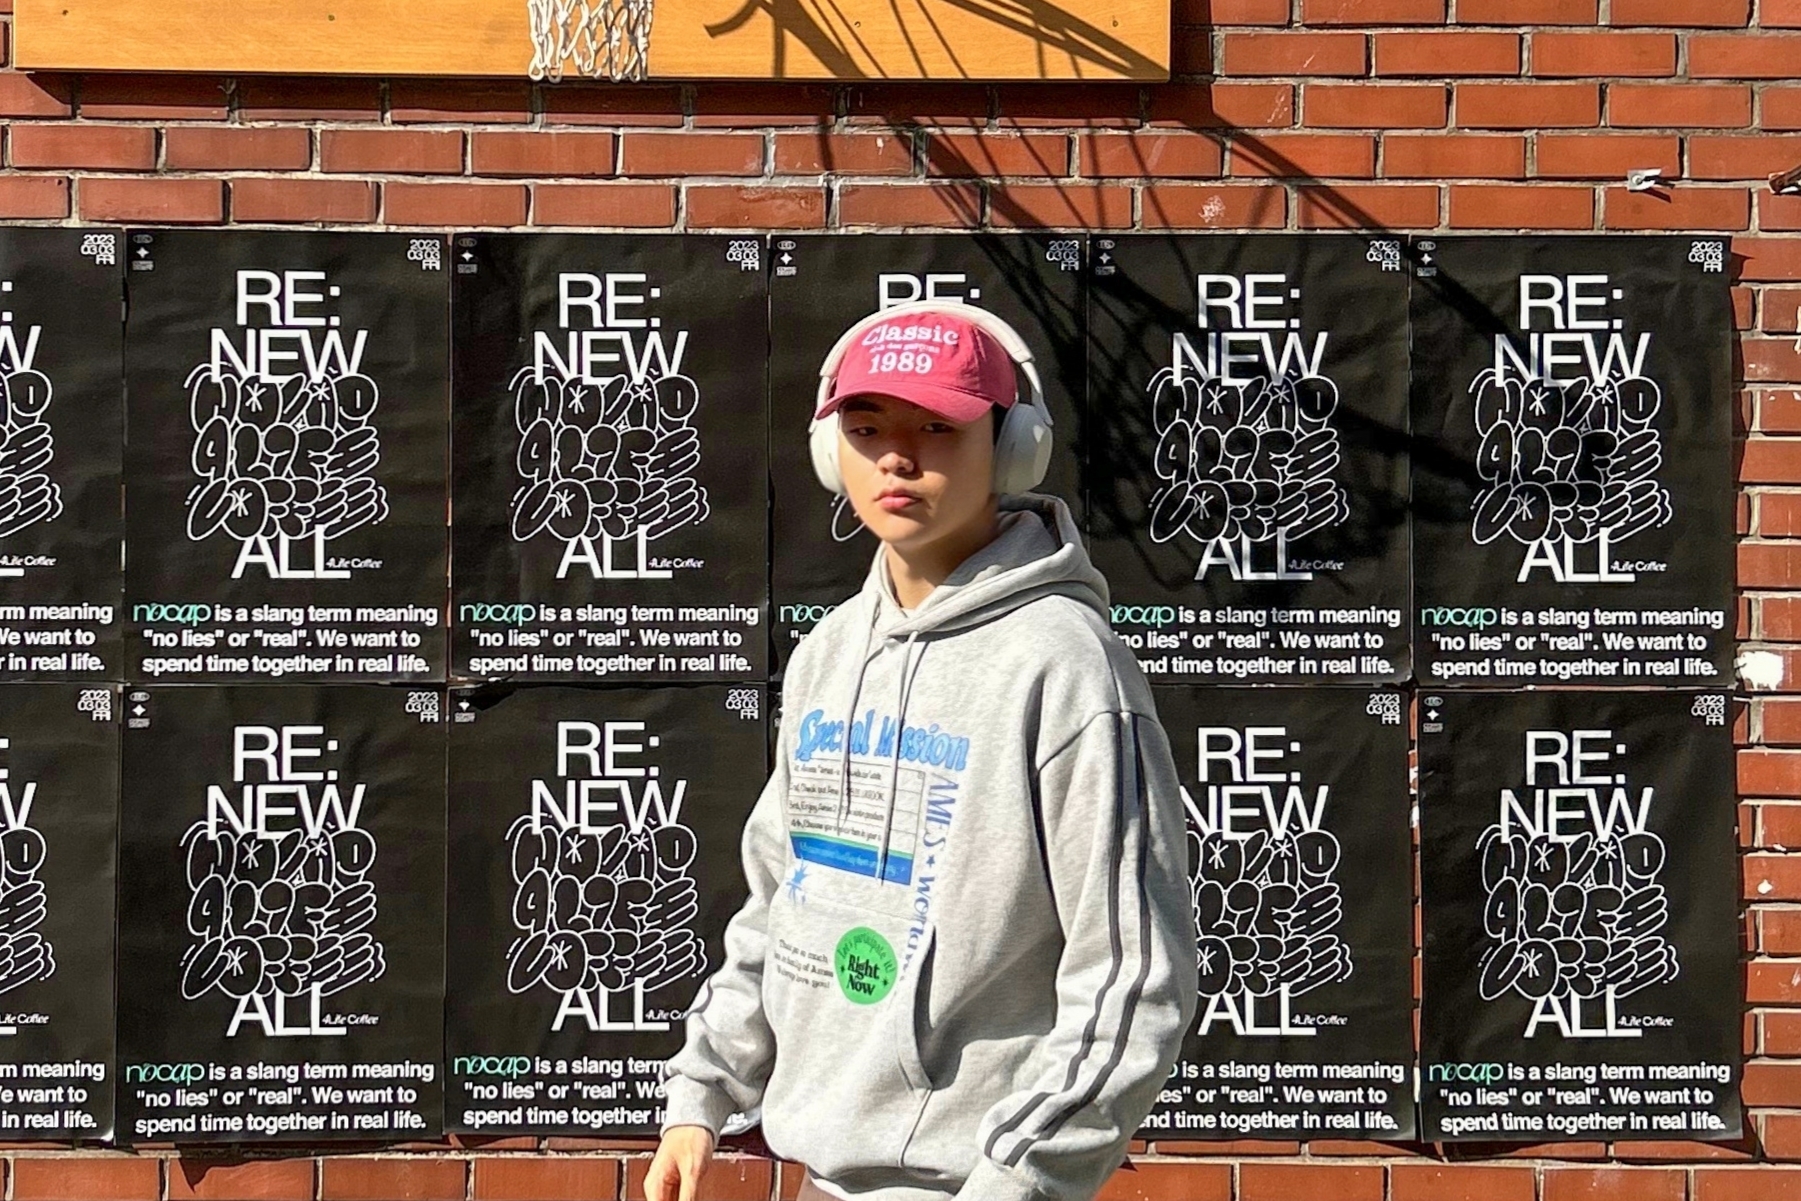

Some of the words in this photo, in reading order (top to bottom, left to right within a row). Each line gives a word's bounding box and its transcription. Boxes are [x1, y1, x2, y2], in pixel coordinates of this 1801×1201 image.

[84, 234, 114, 245] 2023
[410, 239, 440, 250] 2023
[1049, 240, 1079, 251] 2023
[1690, 242, 1720, 253] 2023
[96, 254, 114, 265] FRI
[422, 259, 440, 270] FRI
[1061, 260, 1079, 270] FRI
[1702, 262, 1720, 273] FRI
[236, 270, 340, 326] RE:
[558, 272, 660, 328] RE:
[1196, 273, 1299, 329] RE:
[1518, 274, 1621, 330] RE:
[861, 323, 959, 346] Classic
[211, 328, 368, 383] NEW
[534, 330, 688, 385] NEW
[867, 352, 933, 374] 1989
[1172, 331, 1327, 386] NEW
[1494, 332, 1650, 387] NEW
[24, 555, 57, 566] Coffee
[230, 525, 351, 579] ALL
[554, 525, 673, 579] ALL
[1193, 527, 1313, 581] ALL
[1516, 528, 1636, 582] ALL
[1636, 560, 1668, 571] Coffee
[0, 605, 26, 620] rm
[28, 602, 113, 625] meaning
[133, 603, 211, 627] nocap
[214, 604, 232, 622] is
[235, 607, 248, 622] a
[251, 604, 304, 627] slang
[308, 605, 352, 622] term
[355, 604, 438, 627] meaning
[1421, 607, 1498, 631] nocap
[1501, 608, 1518, 626] is
[1521, 611, 1534, 626] a
[1537, 607, 1590, 630] slang
[1594, 608, 1638, 625] term
[1641, 607, 1724, 630] meaning
[23, 629, 71, 645] want
[74, 628, 94, 646] to
[143, 629, 178, 647] "no
[181, 629, 225, 647] lies"
[227, 632, 250, 647] or
[253, 629, 312, 647] "real".
[315, 629, 347, 647] We
[350, 631, 397, 647] want
[400, 630, 420, 648] to
[470, 629, 504, 647] "no
[507, 629, 550, 647] lies"
[552, 632, 574, 647] or
[577, 629, 635, 646] "real".
[638, 629, 670, 646] We
[673, 630, 719, 646] want
[722, 629, 742, 647] to
[1146, 631, 1189, 649] lies"
[1191, 634, 1214, 649] or
[1217, 631, 1275, 649] "real".
[1278, 631, 1310, 649] We
[1313, 633, 1360, 649] want
[1363, 632, 1383, 650] to
[8, 652, 26, 671] in
[30, 652, 67, 672] real
[70, 652, 105, 672] life.
[142, 654, 202, 677] spend
[205, 654, 249, 673] time
[252, 654, 333, 677] together
[335, 654, 353, 672] in
[357, 654, 393, 673] real
[396, 654, 430, 673] life.
[80, 690, 111, 701] 2023
[729, 688, 759, 700] 2023
[92, 710, 111, 721] FRI
[741, 709, 759, 720] FRI
[556, 720, 659, 777] RE:
[795, 709, 876, 762] Specal
[874, 715, 970, 772] Mssion
[233, 725, 338, 782] RE:
[1196, 726, 1300, 782] RE:
[1521, 729, 1625, 785] RE:
[207, 784, 366, 839] NEW
[531, 779, 687, 834] NEW
[922, 772, 960, 851] AMES
[1498, 787, 1655, 843] NEW
[847, 953, 880, 980] Right
[846, 974, 876, 996] Now
[225, 982, 347, 1037] ALL
[550, 977, 670, 1031] ALL
[1196, 982, 1316, 1036] ALL
[1522, 984, 1642, 1038] ALL
[20, 1060, 106, 1083] meaning
[1428, 1063, 1505, 1086] nocap
[1508, 1063, 1526, 1081] is
[1529, 1066, 1541, 1081] a
[1544, 1063, 1597, 1085] slang
[1601, 1063, 1644, 1080] term
[1648, 1062, 1730, 1084] meaning
[15, 1088, 63, 1104] want
[67, 1086, 87, 1104] to
[137, 1090, 172, 1108] "no
[175, 1089, 219, 1107] lies"
[221, 1091, 245, 1106] or
[248, 1087, 307, 1105] "real".
[310, 1086, 342, 1104] We
[346, 1087, 393, 1104] want
[396, 1086, 416, 1104] to
[464, 1082, 498, 1100] "no
[501, 1082, 545, 1100] lies"
[547, 1084, 570, 1099] or
[573, 1081, 631, 1099] "real".
[0, 1112, 18, 1130] in
[22, 1111, 59, 1130] real
[62, 1110, 97, 1129] life.
[1173, 1110, 1217, 1129] time
[1220, 1111, 1300, 1133] together
[1302, 1111, 1320, 1128] in
[1324, 1111, 1360, 1130] real
[1363, 1111, 1397, 1130] life.
[1438, 1113, 1497, 1135] spend
[1500, 1112, 1544, 1131] time
[1547, 1112, 1627, 1135] together
[1629, 1112, 1647, 1129] in
[1651, 1111, 1686, 1130] real
[1689, 1111, 1723, 1130] life.
